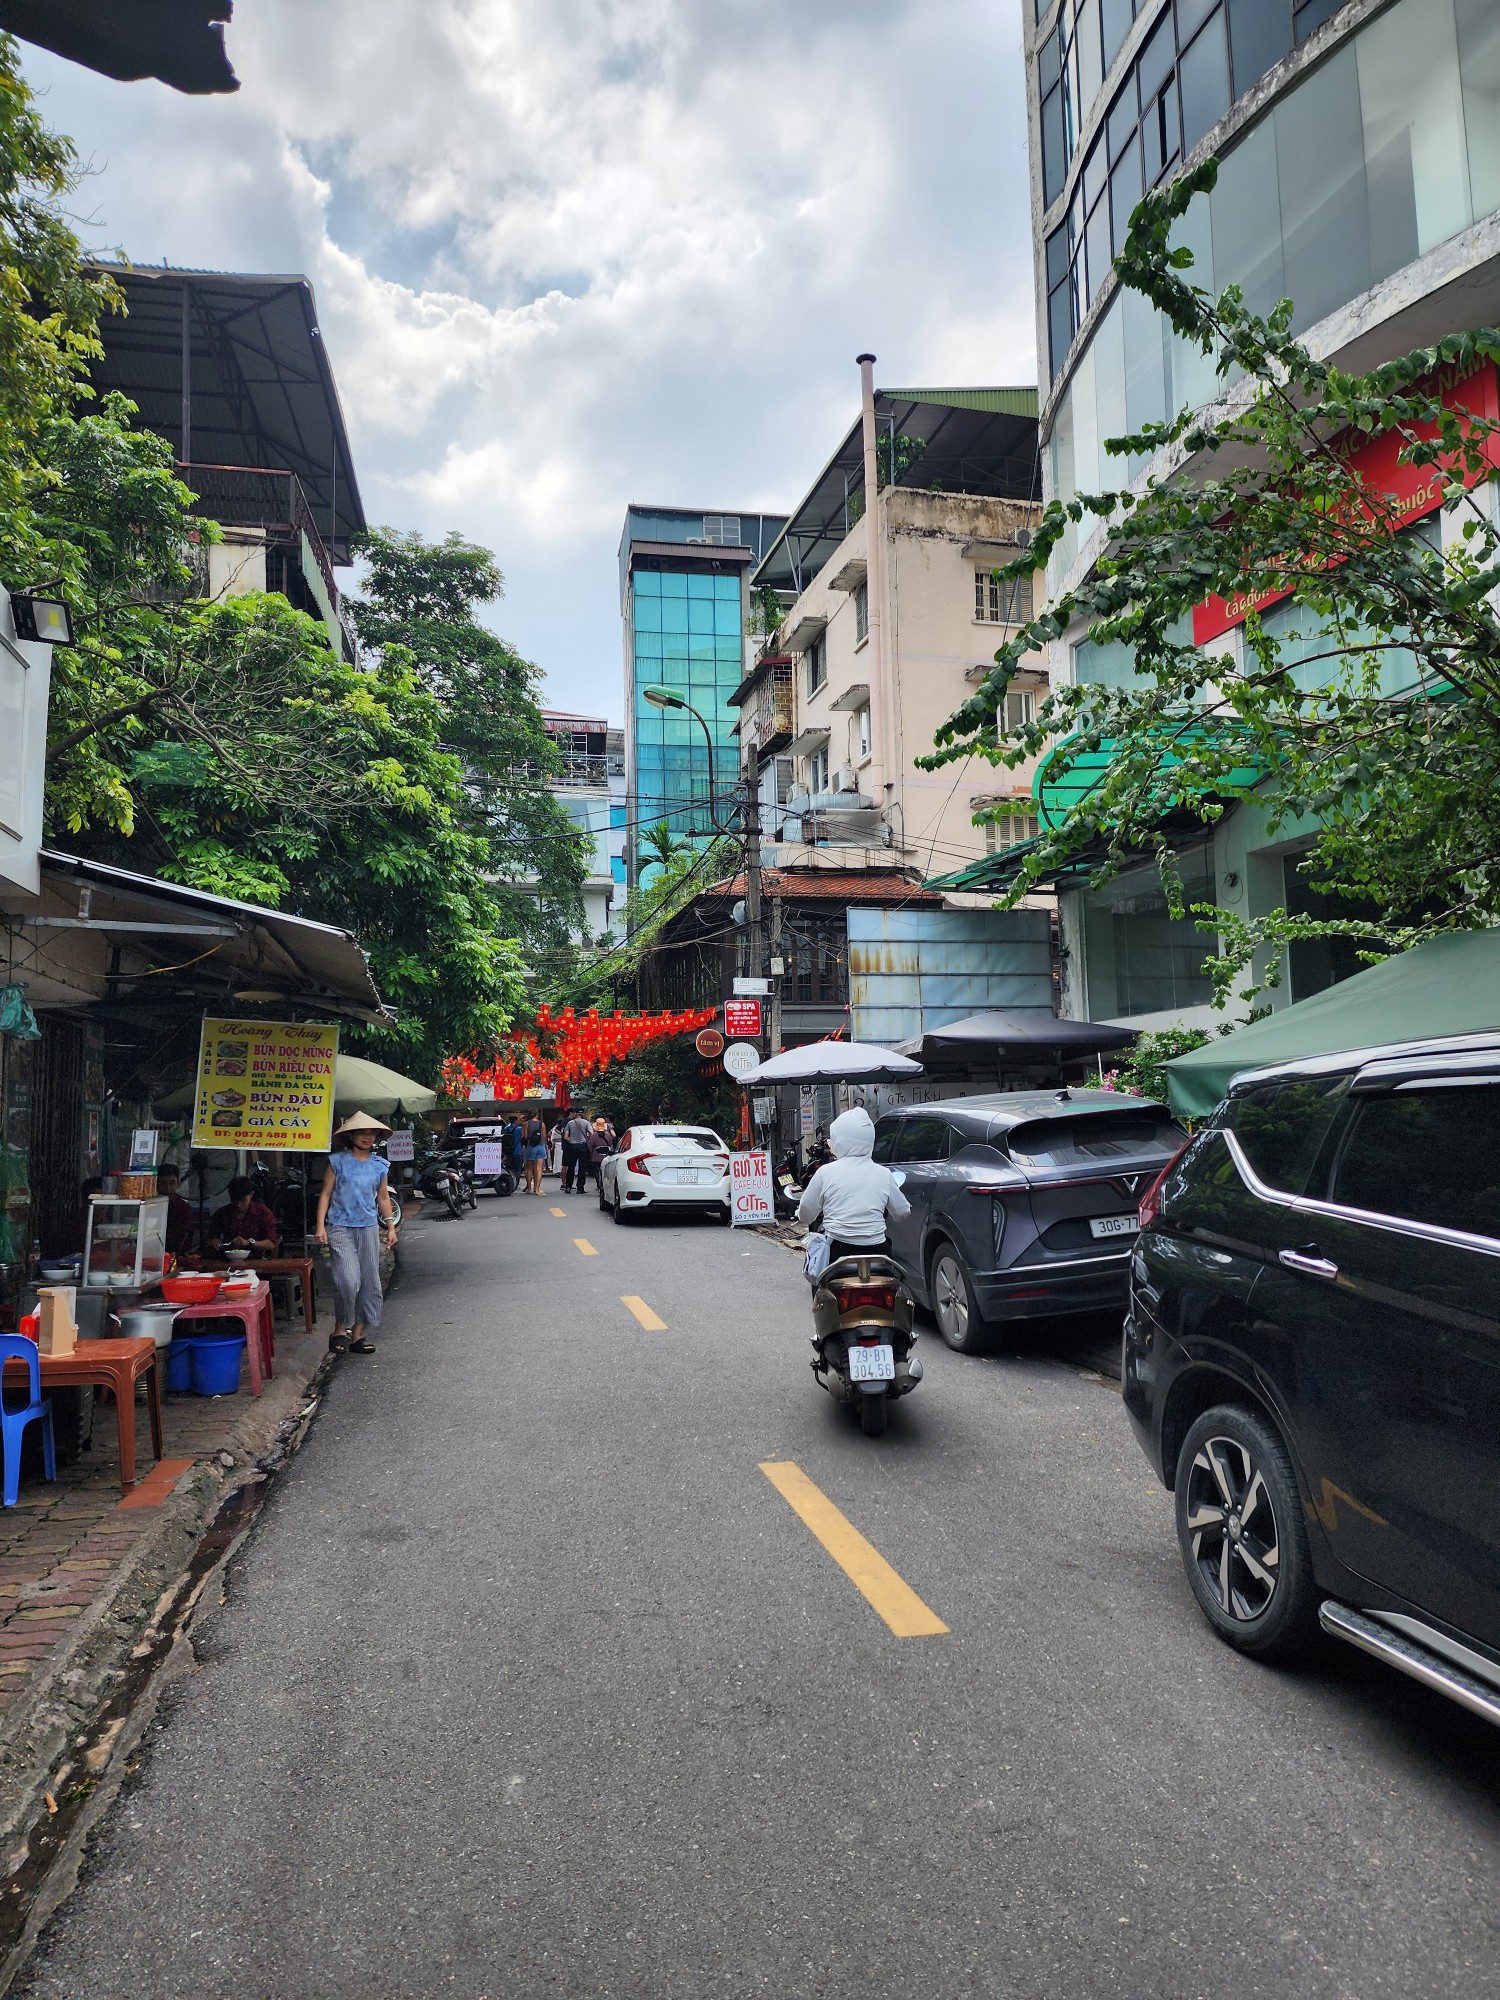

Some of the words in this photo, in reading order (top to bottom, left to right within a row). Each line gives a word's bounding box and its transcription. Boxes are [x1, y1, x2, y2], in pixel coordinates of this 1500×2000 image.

[253, 1042, 276, 1056] BÚN
[279, 1045, 300, 1060] DỌC
[302, 1044, 333, 1060] MÙNG
[252, 1058, 276, 1072] BÚN
[279, 1060, 306, 1074] RIÊU
[308, 1063, 331, 1074] CUA
[251, 1079, 282, 1089] BÁNH
[302, 1082, 325, 1090] CUA
[250, 1092, 284, 1104] BÚN
[288, 1093, 324, 1107] ĐẬU
[248, 1115, 275, 1127] GIẢ
[266, 1131, 288, 1139] 488
[292, 1132, 312, 1140] 168
[733, 1155, 751, 1178] GỬI
[754, 1159, 767, 1176] XE
[737, 1194, 768, 1212] CITTA
[854, 1364, 892, 1379] 304.56
